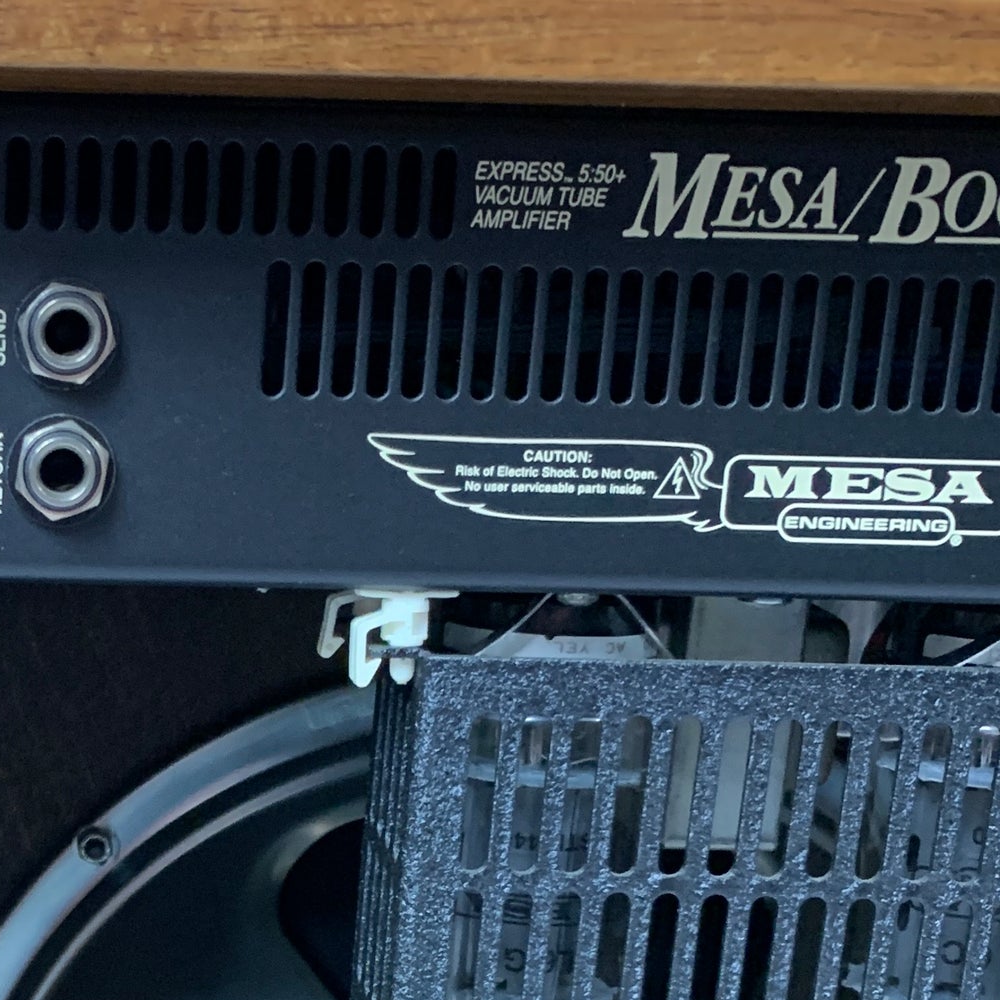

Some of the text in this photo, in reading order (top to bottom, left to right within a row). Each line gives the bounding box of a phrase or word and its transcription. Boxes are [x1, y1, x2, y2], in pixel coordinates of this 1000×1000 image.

[578, 163, 627, 184] 5:50+
[475, 185, 609, 207] VACUUM TUBE
[470, 209, 572, 231] AMPLIFIER
[523, 450, 593, 463] CAUTION:
[455, 465, 659, 482] Risk of Electric Shock. Do Not Open.
[464, 480, 646, 496] No user serviceable parts inside.
[743, 465, 994, 505] MESA
[783, 515, 949, 533] ENGINEERING
